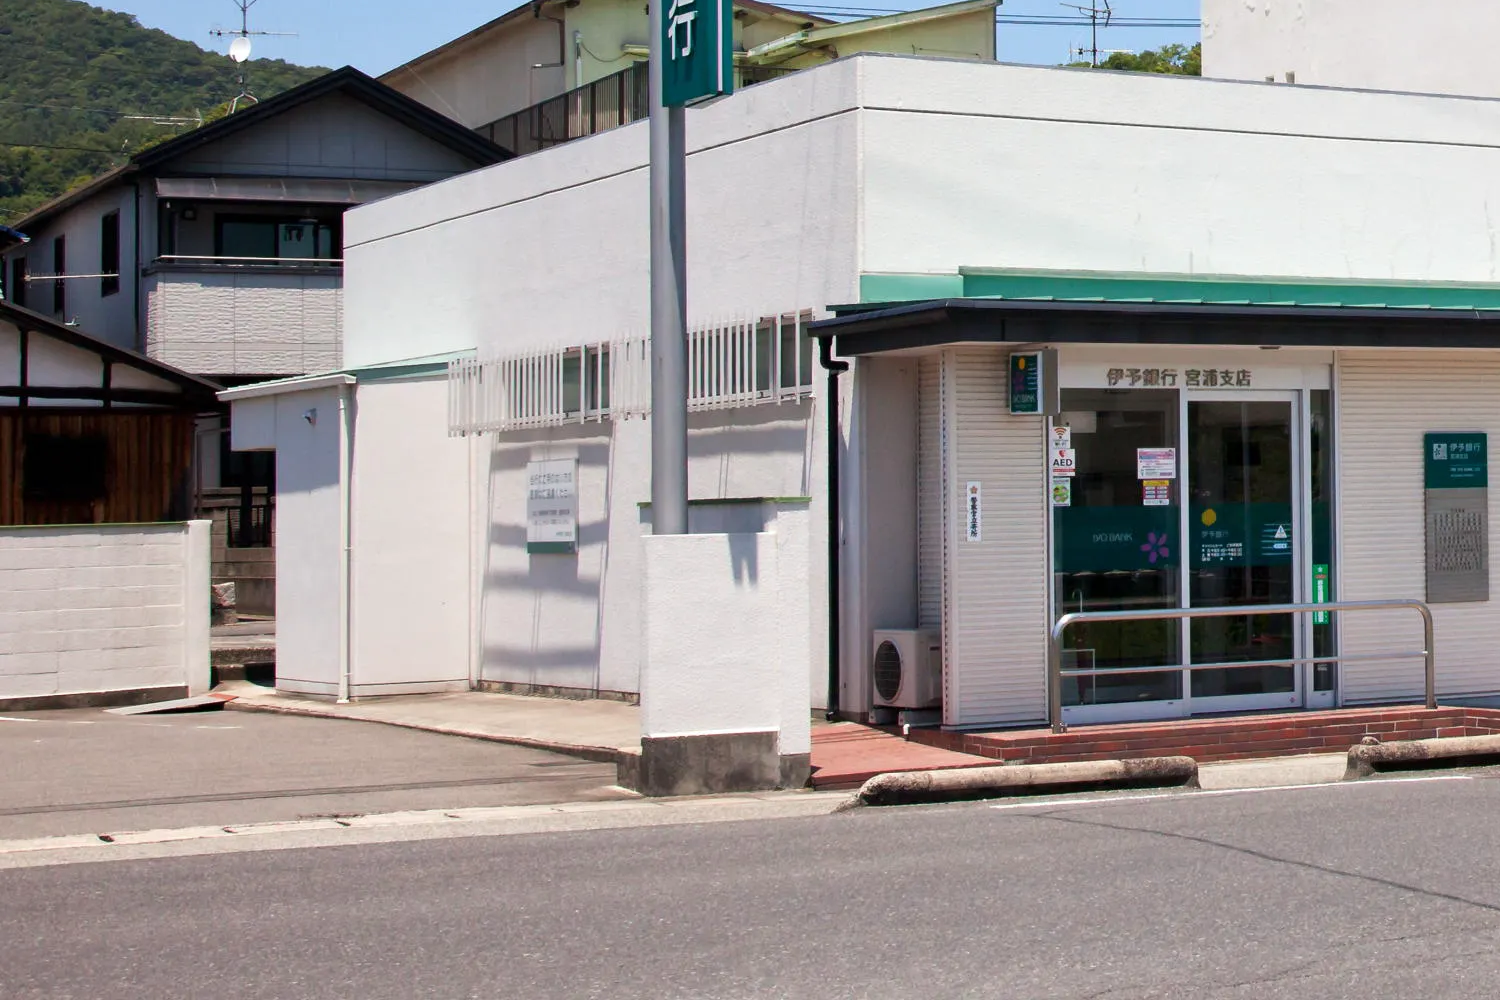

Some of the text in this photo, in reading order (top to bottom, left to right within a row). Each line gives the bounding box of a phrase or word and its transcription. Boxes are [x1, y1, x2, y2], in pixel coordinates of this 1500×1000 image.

[1106, 368, 1252, 388] 伊予銀行 宮浦支店
[1053, 458, 1073, 467] AED
